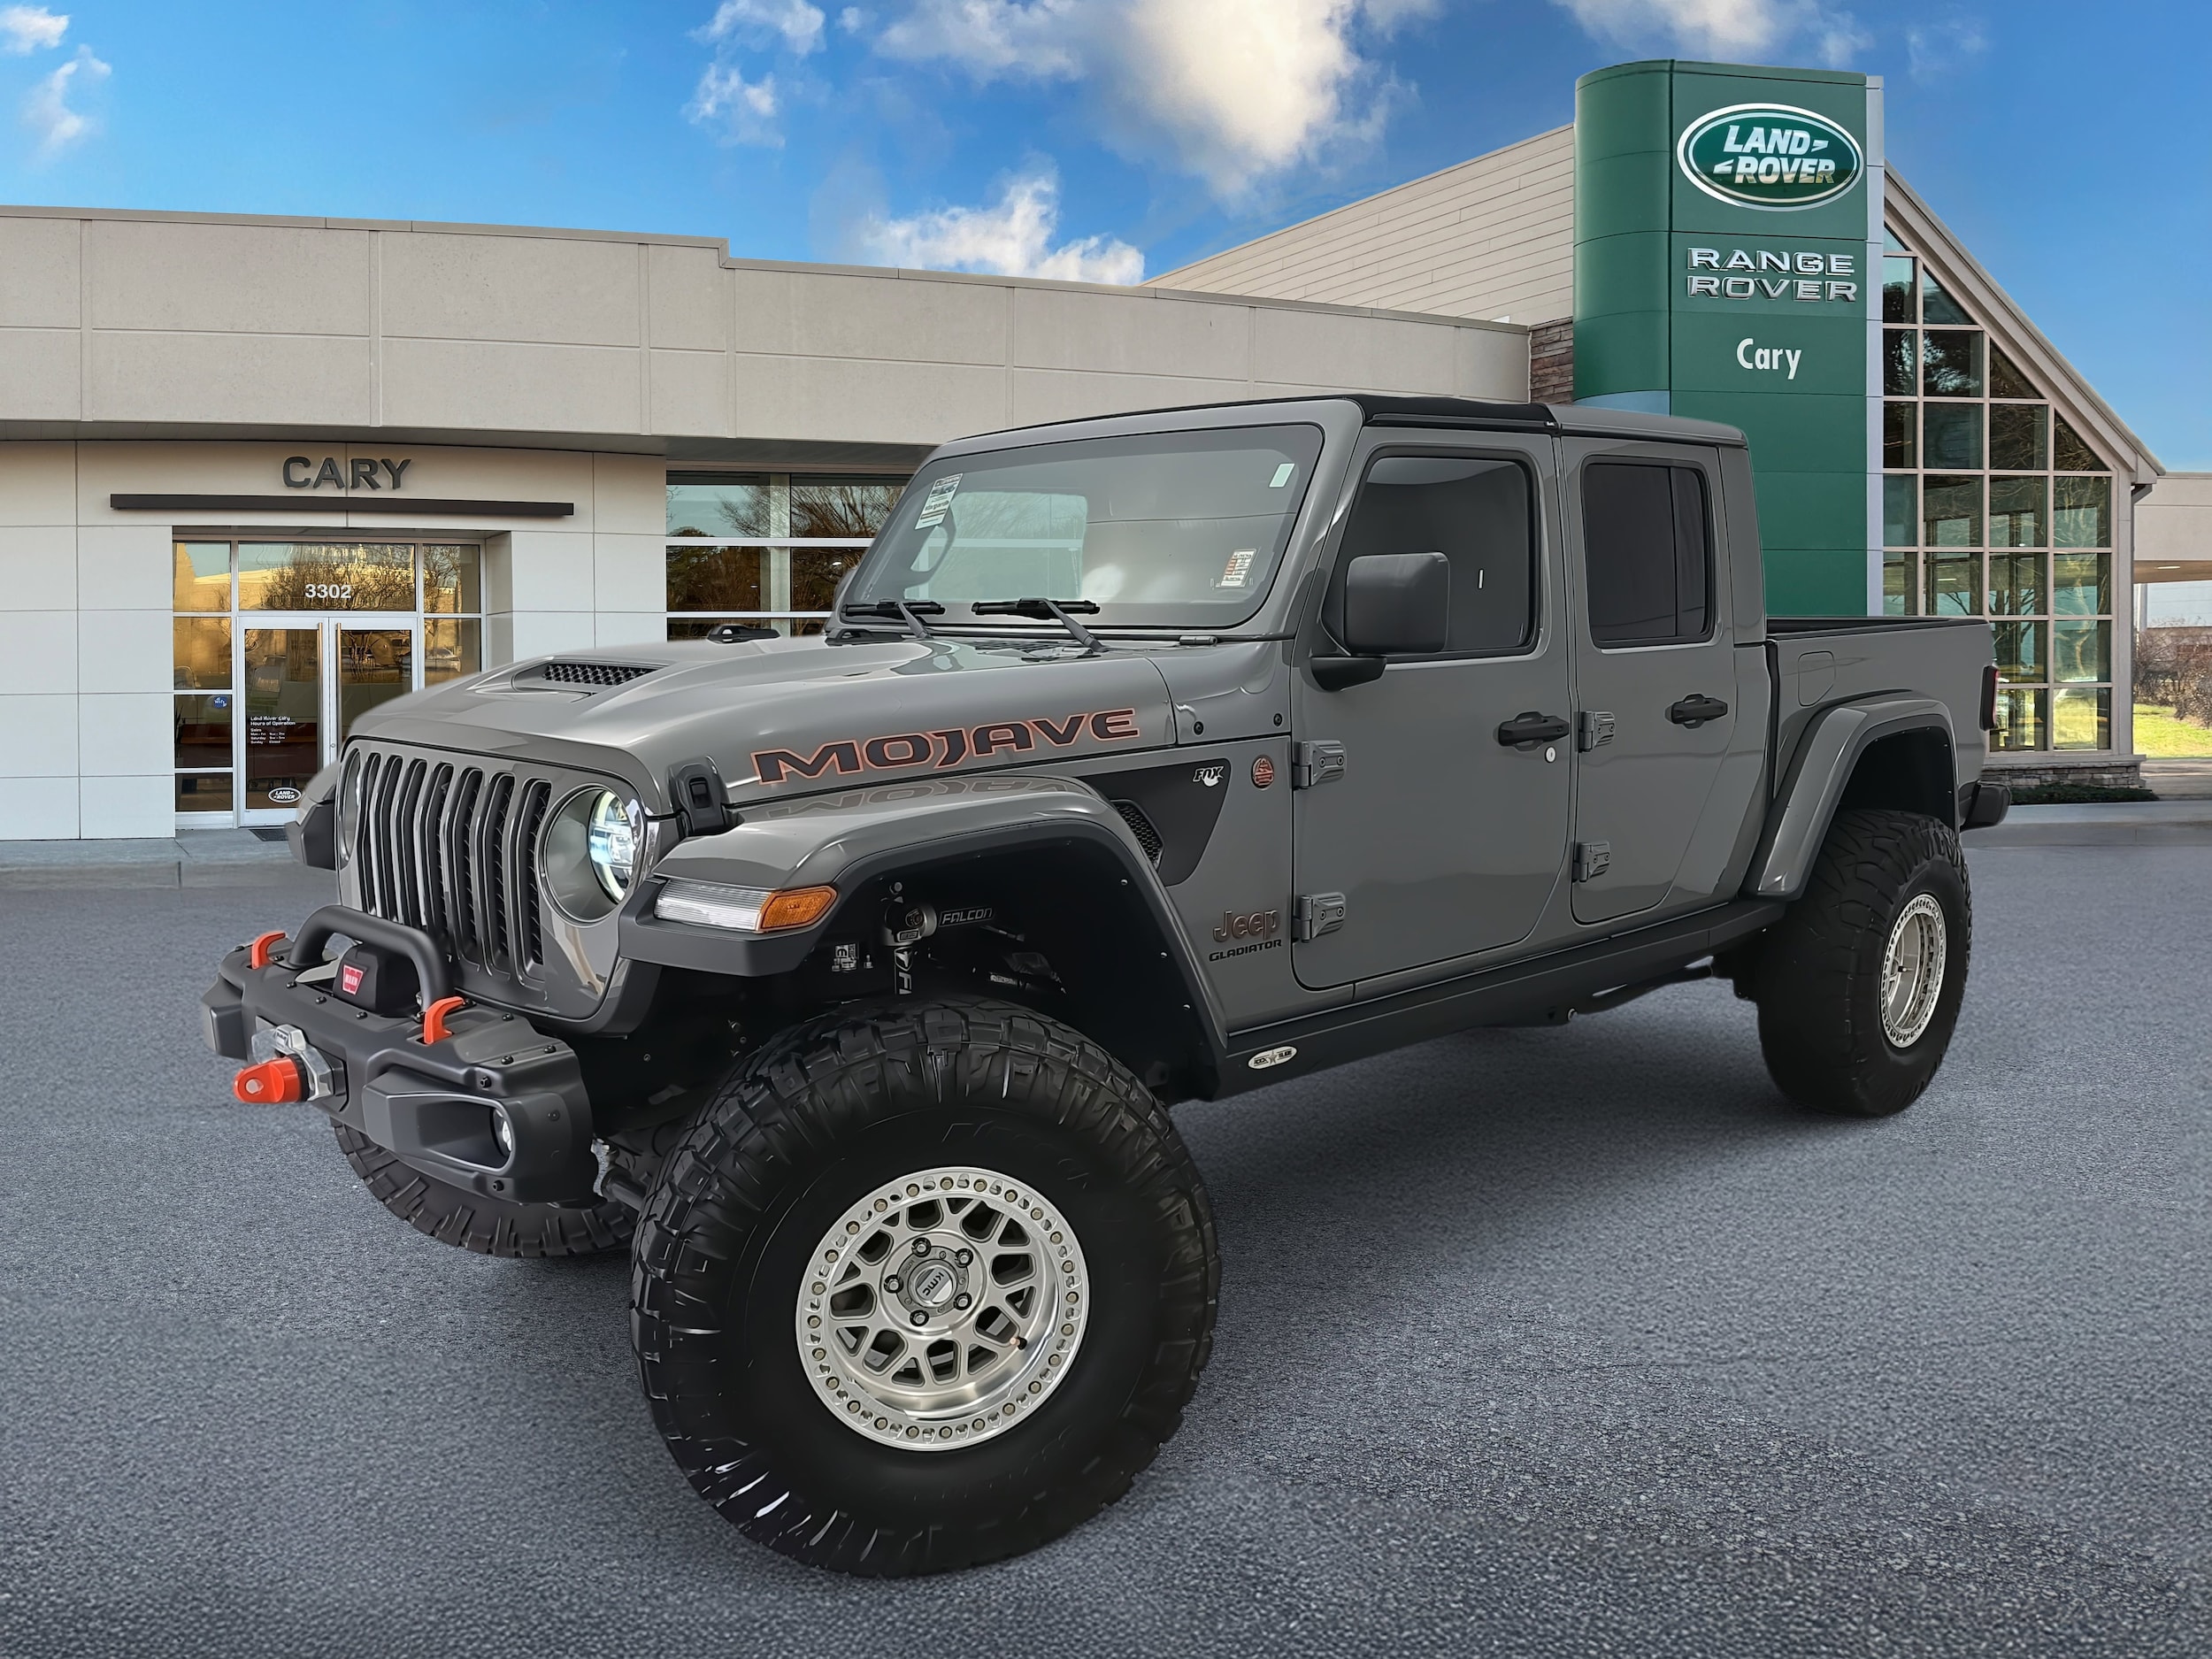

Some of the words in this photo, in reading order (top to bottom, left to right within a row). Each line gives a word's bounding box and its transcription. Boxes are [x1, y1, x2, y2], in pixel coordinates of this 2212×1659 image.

[1723, 125, 1811, 156] LAND
[1734, 156, 1836, 184] ROVER
[1686, 247, 1855, 276] RANGE
[1686, 275, 1858, 303] ROVER
[1736, 337, 1802, 380] Cary
[282, 456, 412, 490] CARY
[303, 583, 352, 600] 3302
[750, 707, 1141, 785] MOJAVE
[1192, 765, 1225, 784] FOX
[941, 907, 994, 926] FALCON
[1213, 910, 1280, 943] Jeep
[1209, 938, 1282, 963] GLADIATOR
